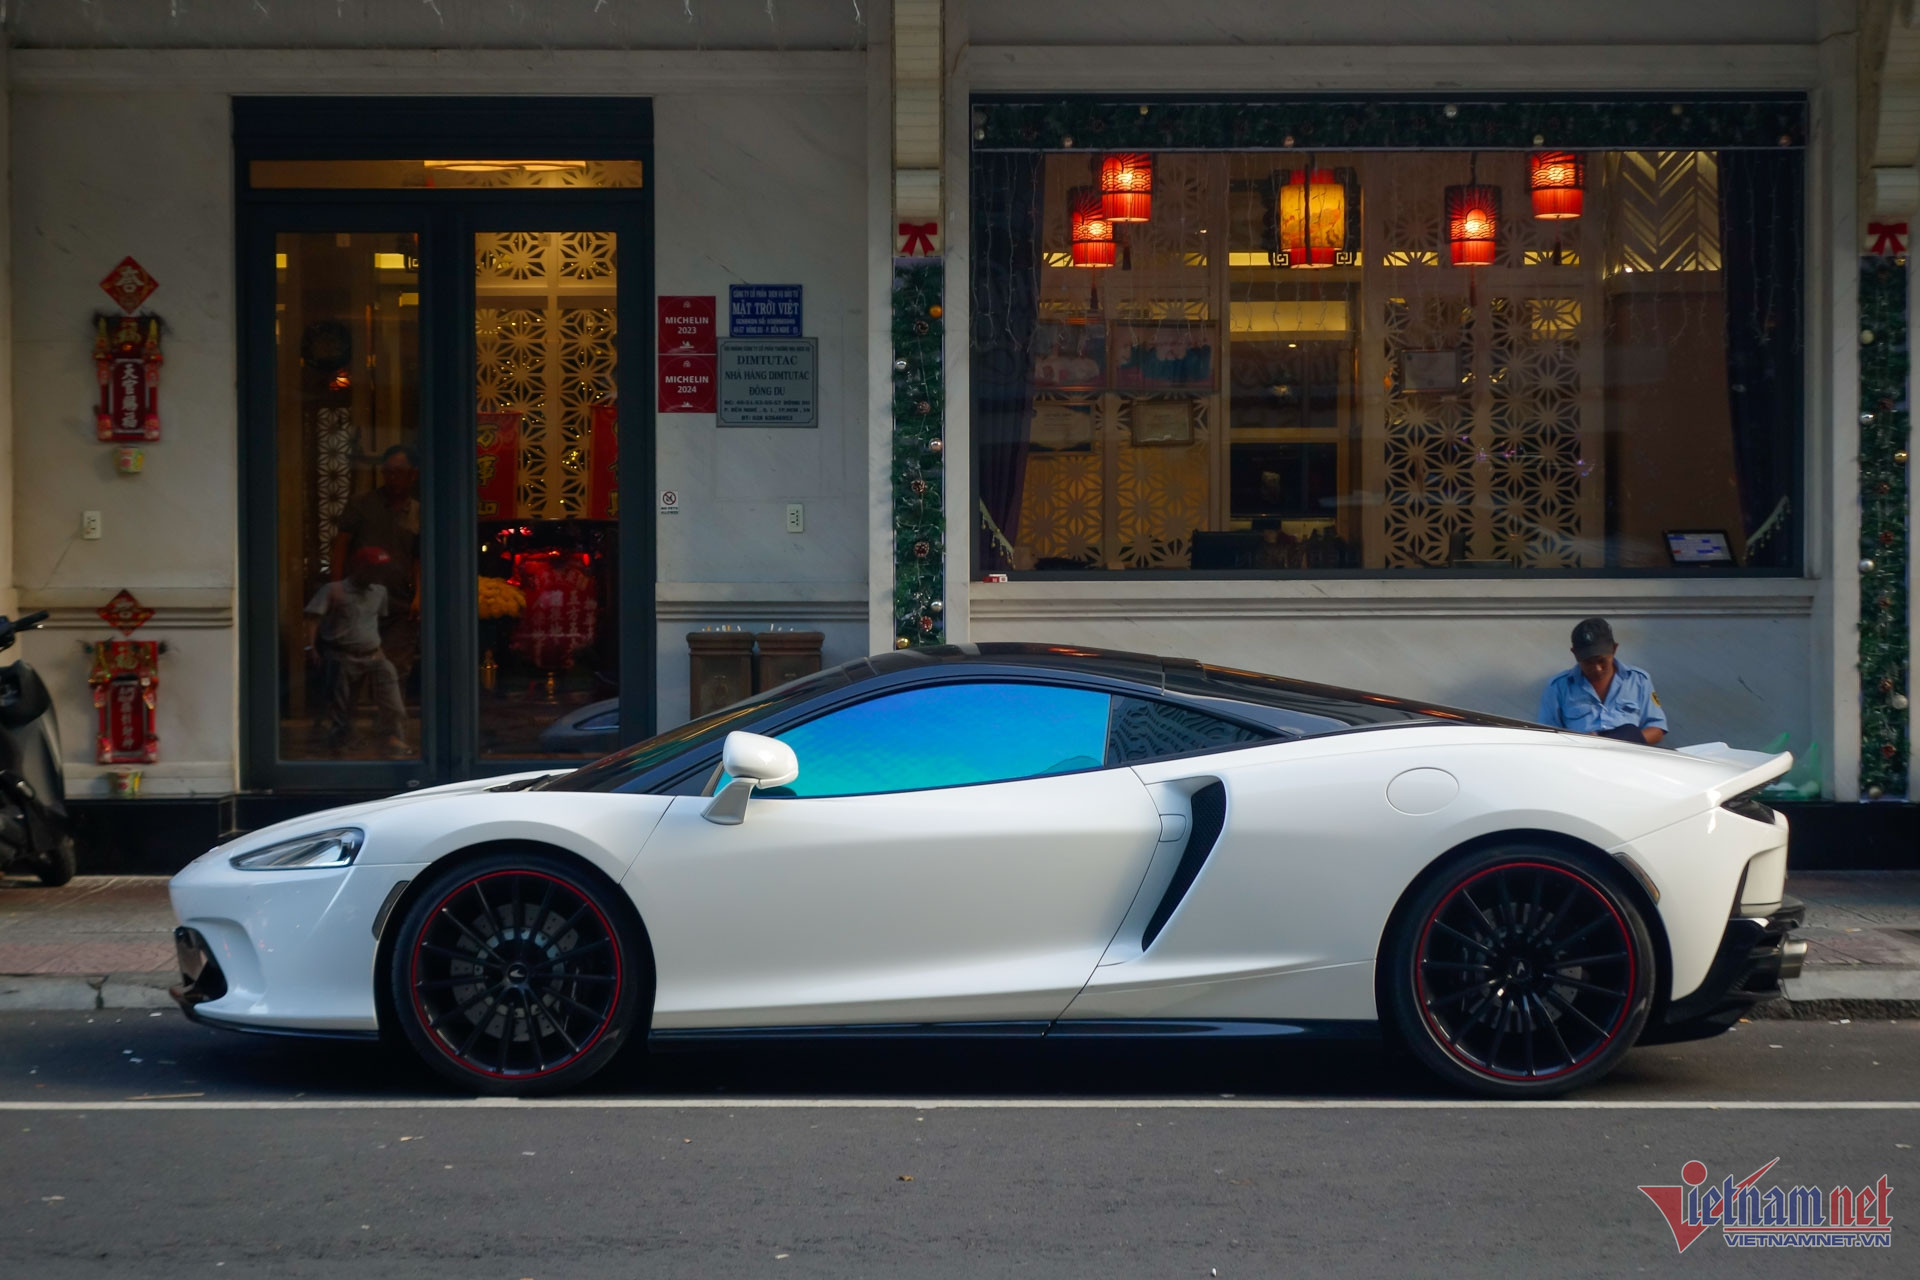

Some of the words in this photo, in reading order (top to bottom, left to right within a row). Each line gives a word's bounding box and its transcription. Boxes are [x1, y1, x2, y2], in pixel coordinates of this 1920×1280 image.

[754, 299, 776, 315] TRỜI
[778, 299, 800, 318] VIỆT
[665, 316, 709, 325] MICHELIN
[677, 326, 697, 335] 2023
[737, 355, 798, 366] DIMTUTAC
[665, 375, 709, 384] MICHELIN
[725, 369, 742, 380] NHÀ
[744, 369, 767, 380] HÀNG
[768, 370, 809, 380] DIMTUTAC
[677, 386, 697, 394] 2024
[749, 384, 772, 396] ĐÔNG
[774, 386, 785, 396] DU
